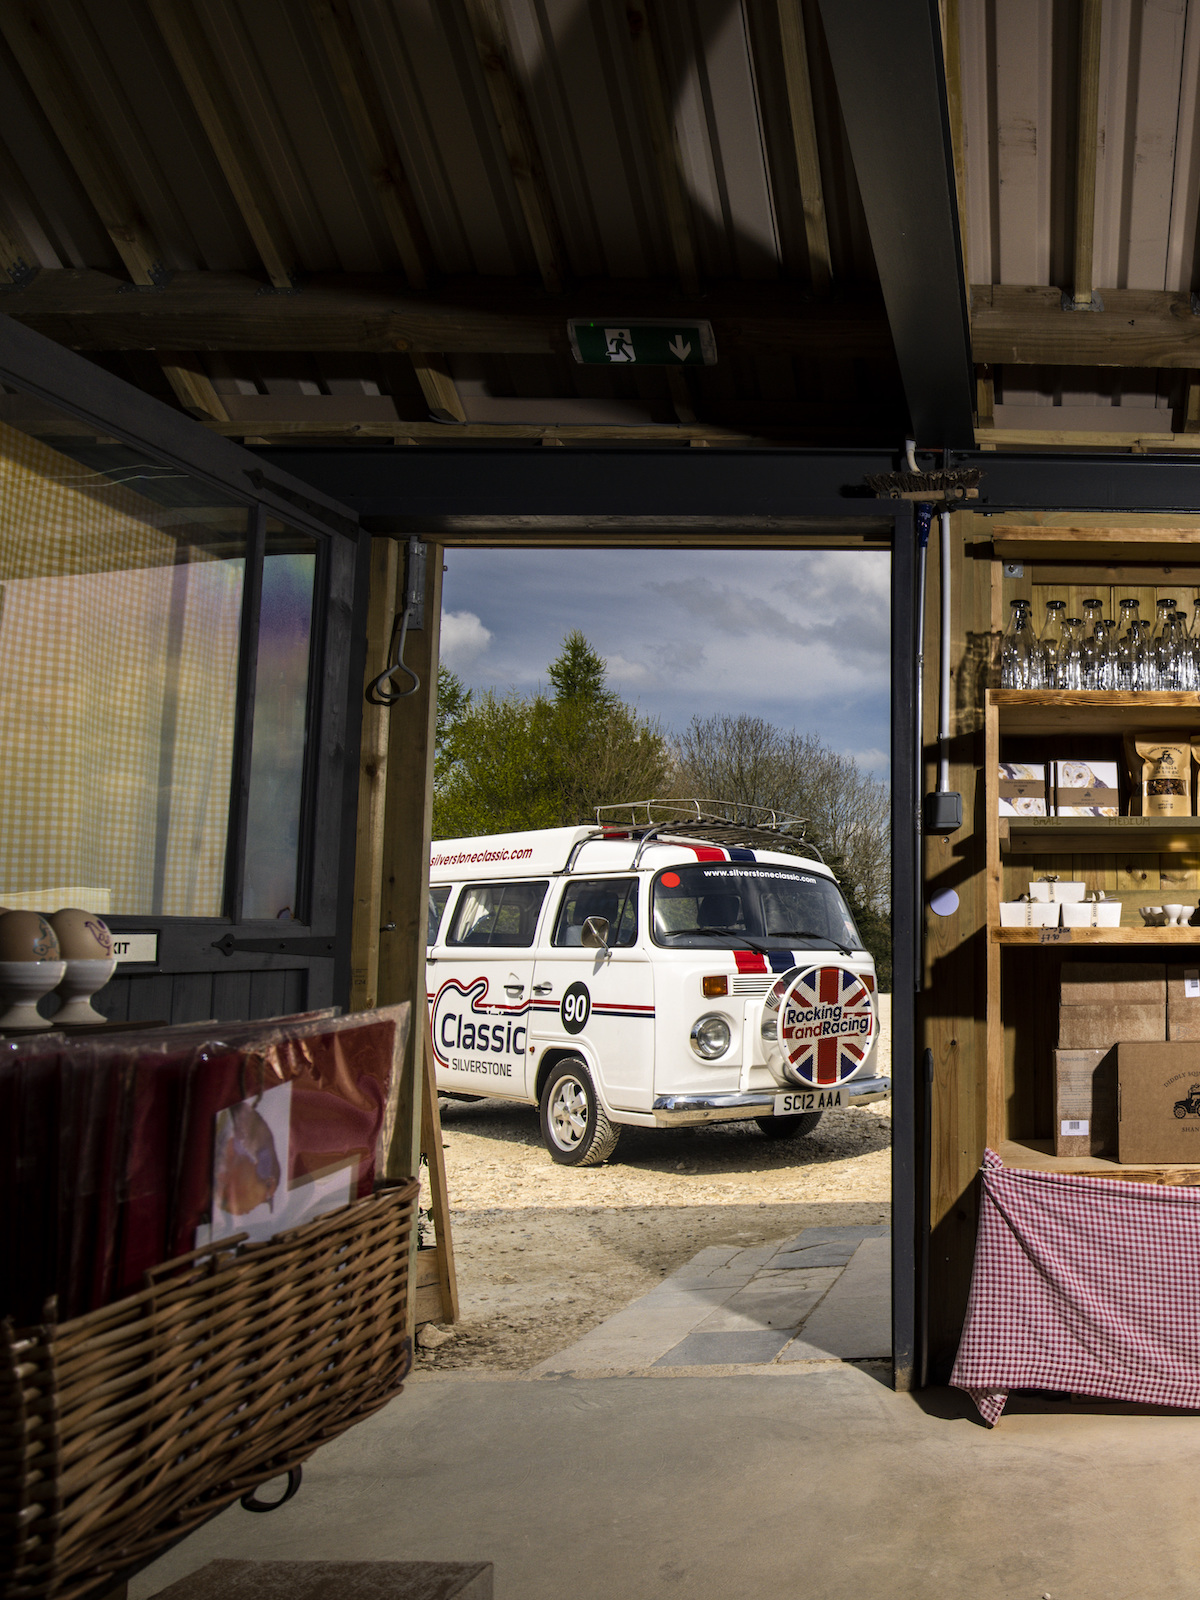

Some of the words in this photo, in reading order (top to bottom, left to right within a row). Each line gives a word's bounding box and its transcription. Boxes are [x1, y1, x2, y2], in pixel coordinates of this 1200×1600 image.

[1109, 817, 1150, 826] MEDIUM
[704, 869, 817, 884] www.silverstoneclassic.com
[564, 994, 586, 1022] 90
[787, 1005, 842, 1024] Rocking
[441, 1013, 526, 1055] Classic
[452, 1058, 512, 1077] SILVERSTONE
[1164, 1072, 1186, 1088] DIDDLY
[818, 1091, 841, 1108] AAA
